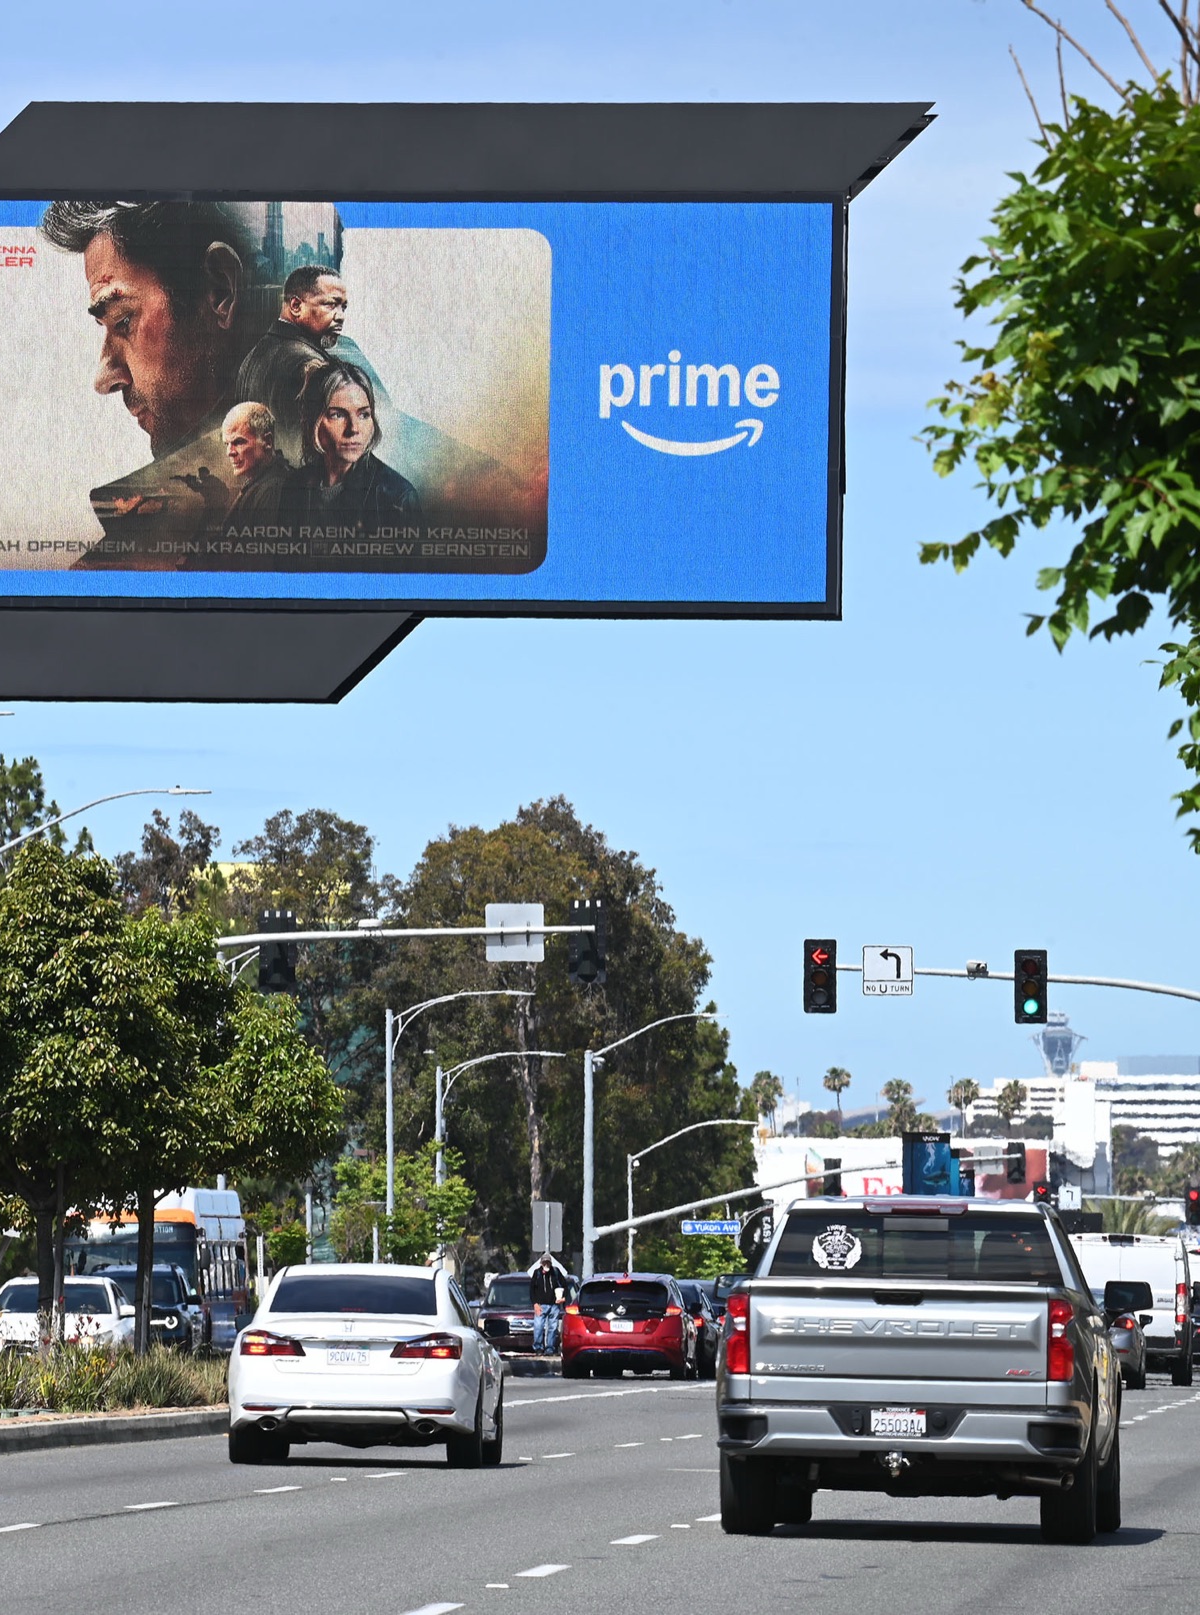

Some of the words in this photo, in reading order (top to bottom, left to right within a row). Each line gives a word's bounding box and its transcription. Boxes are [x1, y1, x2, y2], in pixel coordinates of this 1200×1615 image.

[599, 349, 781, 419] prime
[226, 526, 292, 538] AARON
[300, 526, 356, 539] RABIN
[368, 527, 420, 539] JOHN
[427, 527, 529, 540] KRASINSKI
[27, 540, 136, 552] OPPENHEIM
[148, 541, 200, 553] JOHN
[206, 541, 307, 554] KRASINSKI
[330, 543, 414, 555] ANDREW
[421, 543, 528, 556] BERNSTEIN
[879, 984, 888, 993] U
[769, 1317, 1027, 1338] CHEVROLET
